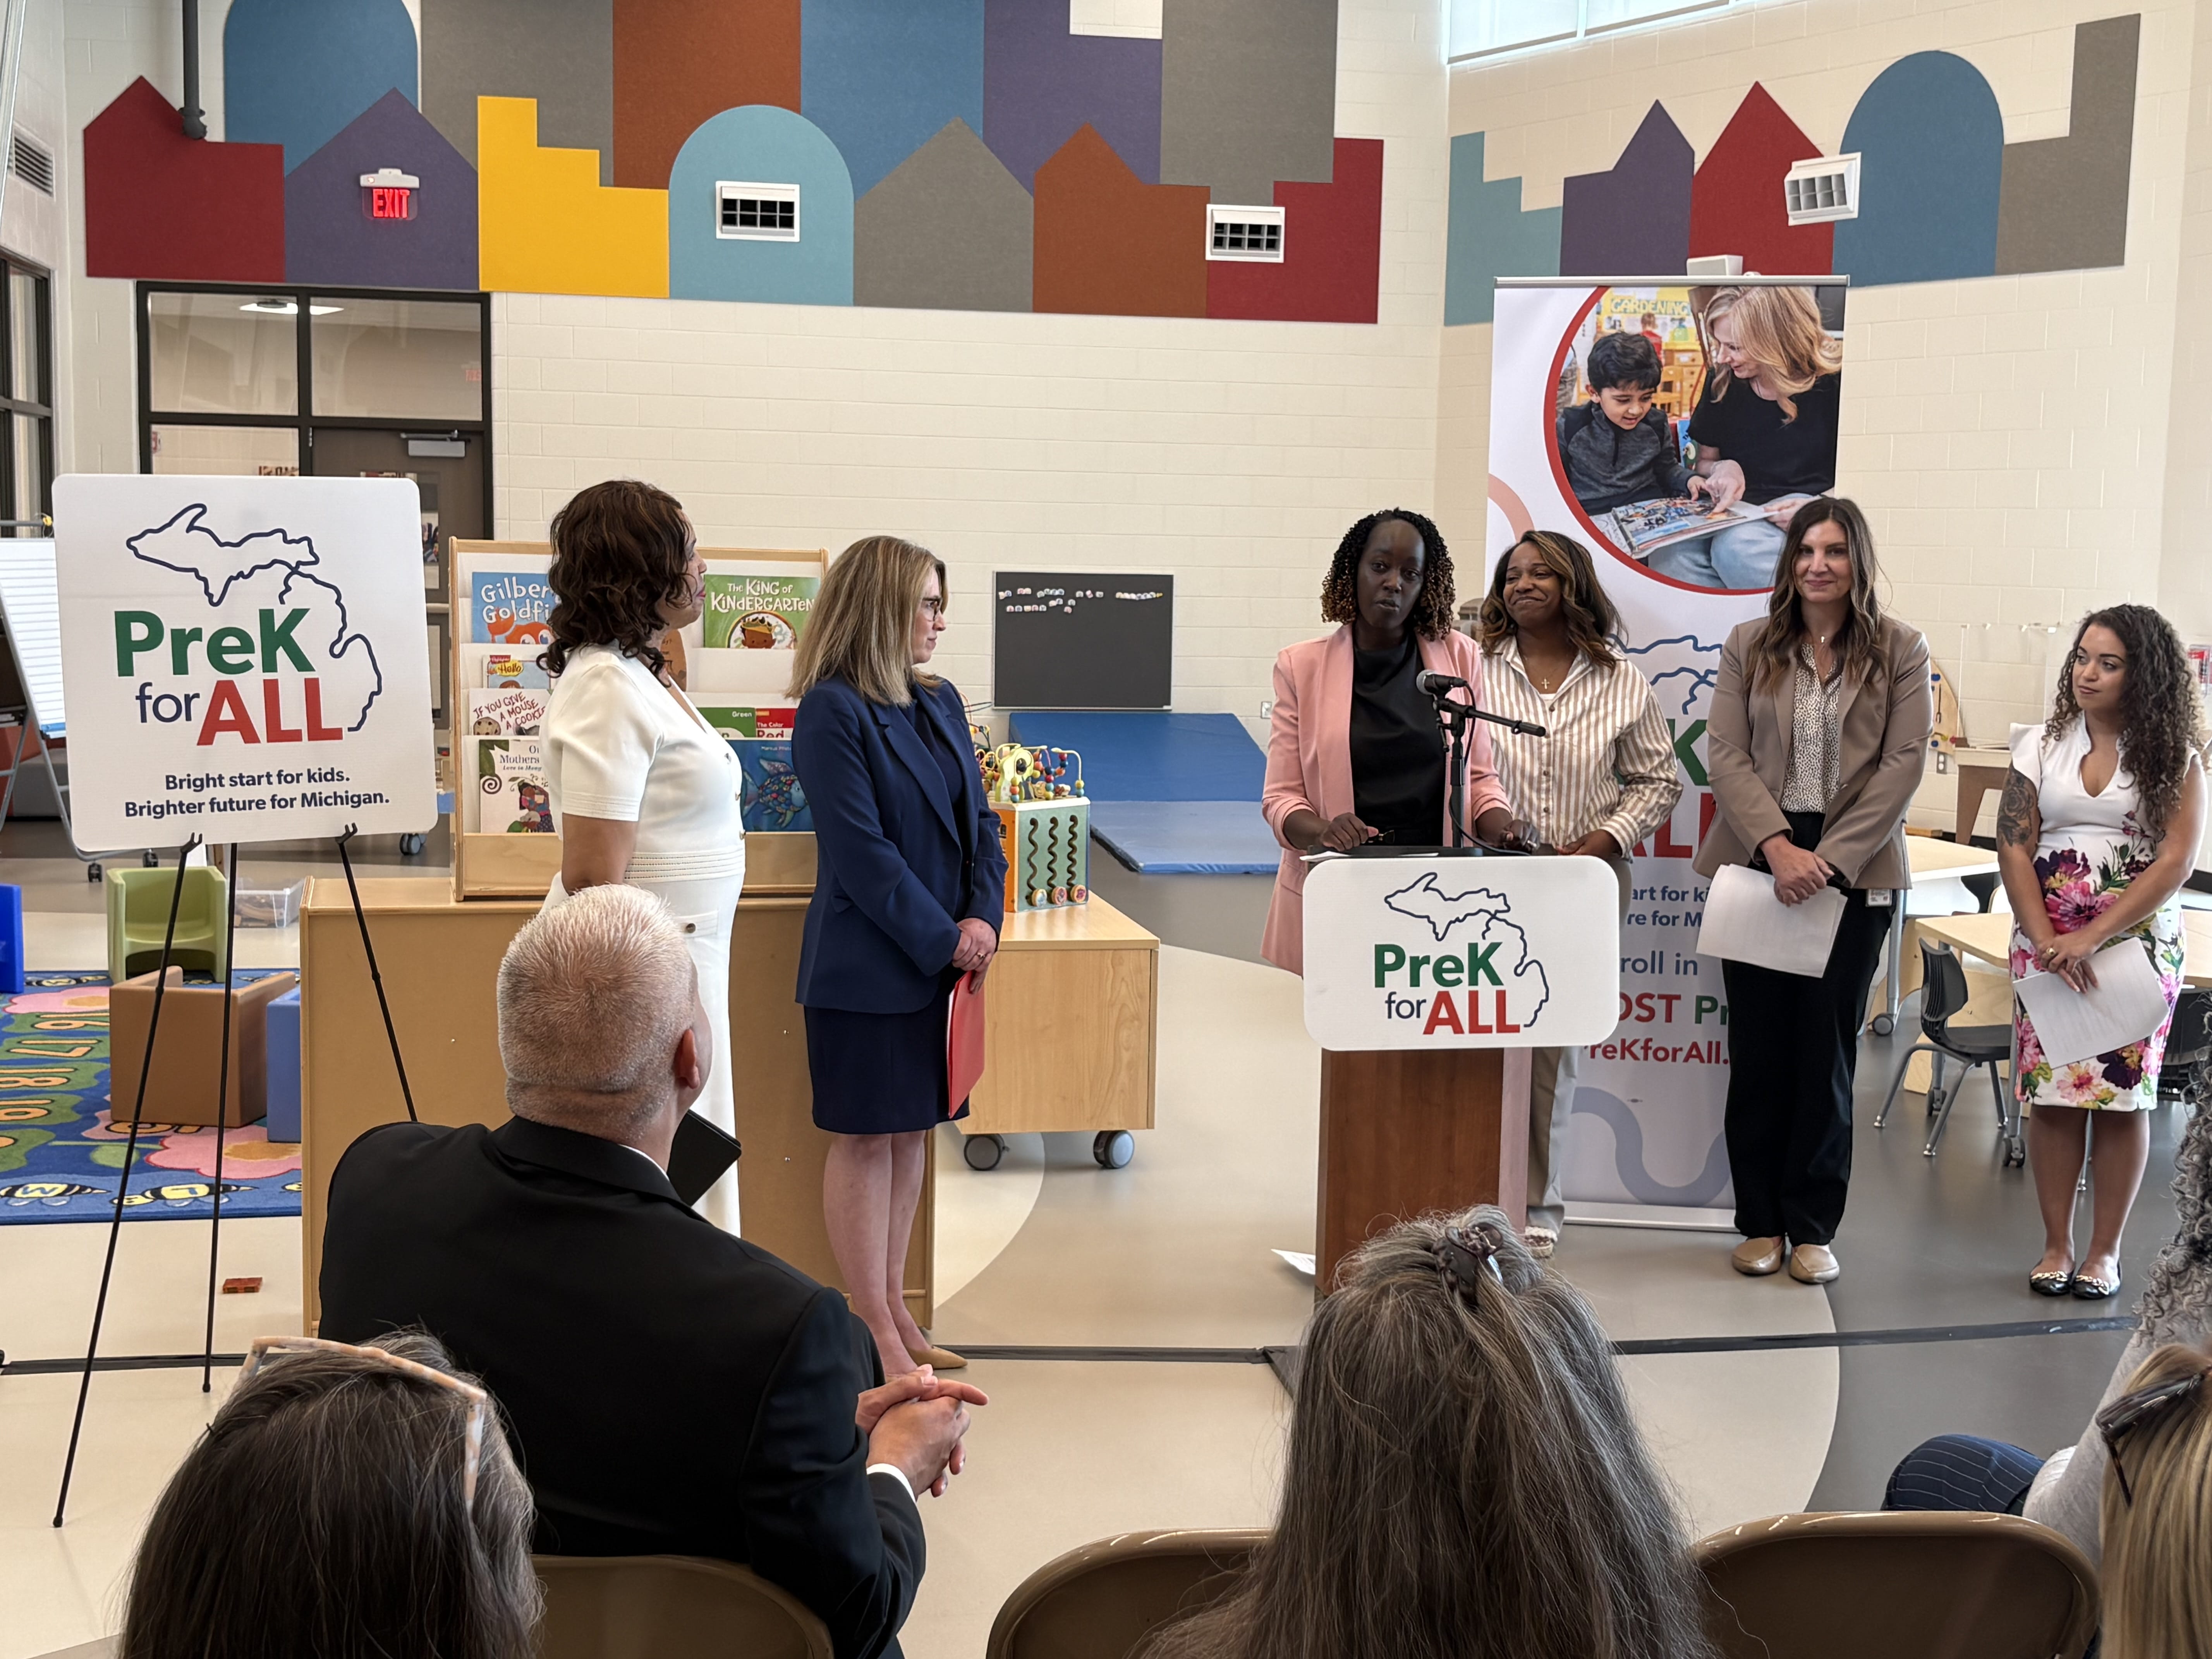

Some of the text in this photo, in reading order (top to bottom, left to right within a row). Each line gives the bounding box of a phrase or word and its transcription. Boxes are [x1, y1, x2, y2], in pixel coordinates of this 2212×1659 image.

[373, 188, 410, 218] EXIT
[1611, 299, 1690, 316] GARDENING
[728, 583, 743, 592] The
[782, 584, 793, 593] of
[115, 608, 316, 677] PreK
[498, 663, 521, 674] Hello
[136, 678, 343, 746] for ALL
[473, 691, 526, 718] IF YOU GIVE
[500, 699, 539, 722] A MOUSE
[507, 721, 512, 730] A
[165, 767, 350, 792] Bright start for kids.
[125, 790, 389, 819] Brighter future for Michigan.
[1661, 885, 1689, 902] for
[1651, 910, 1680, 926] for
[1375, 942, 1504, 988] PreK
[1675, 952, 1698, 975] in
[1385, 990, 1520, 1035] for ALL
[1583, 1037, 1729, 1065] reKforAll.
